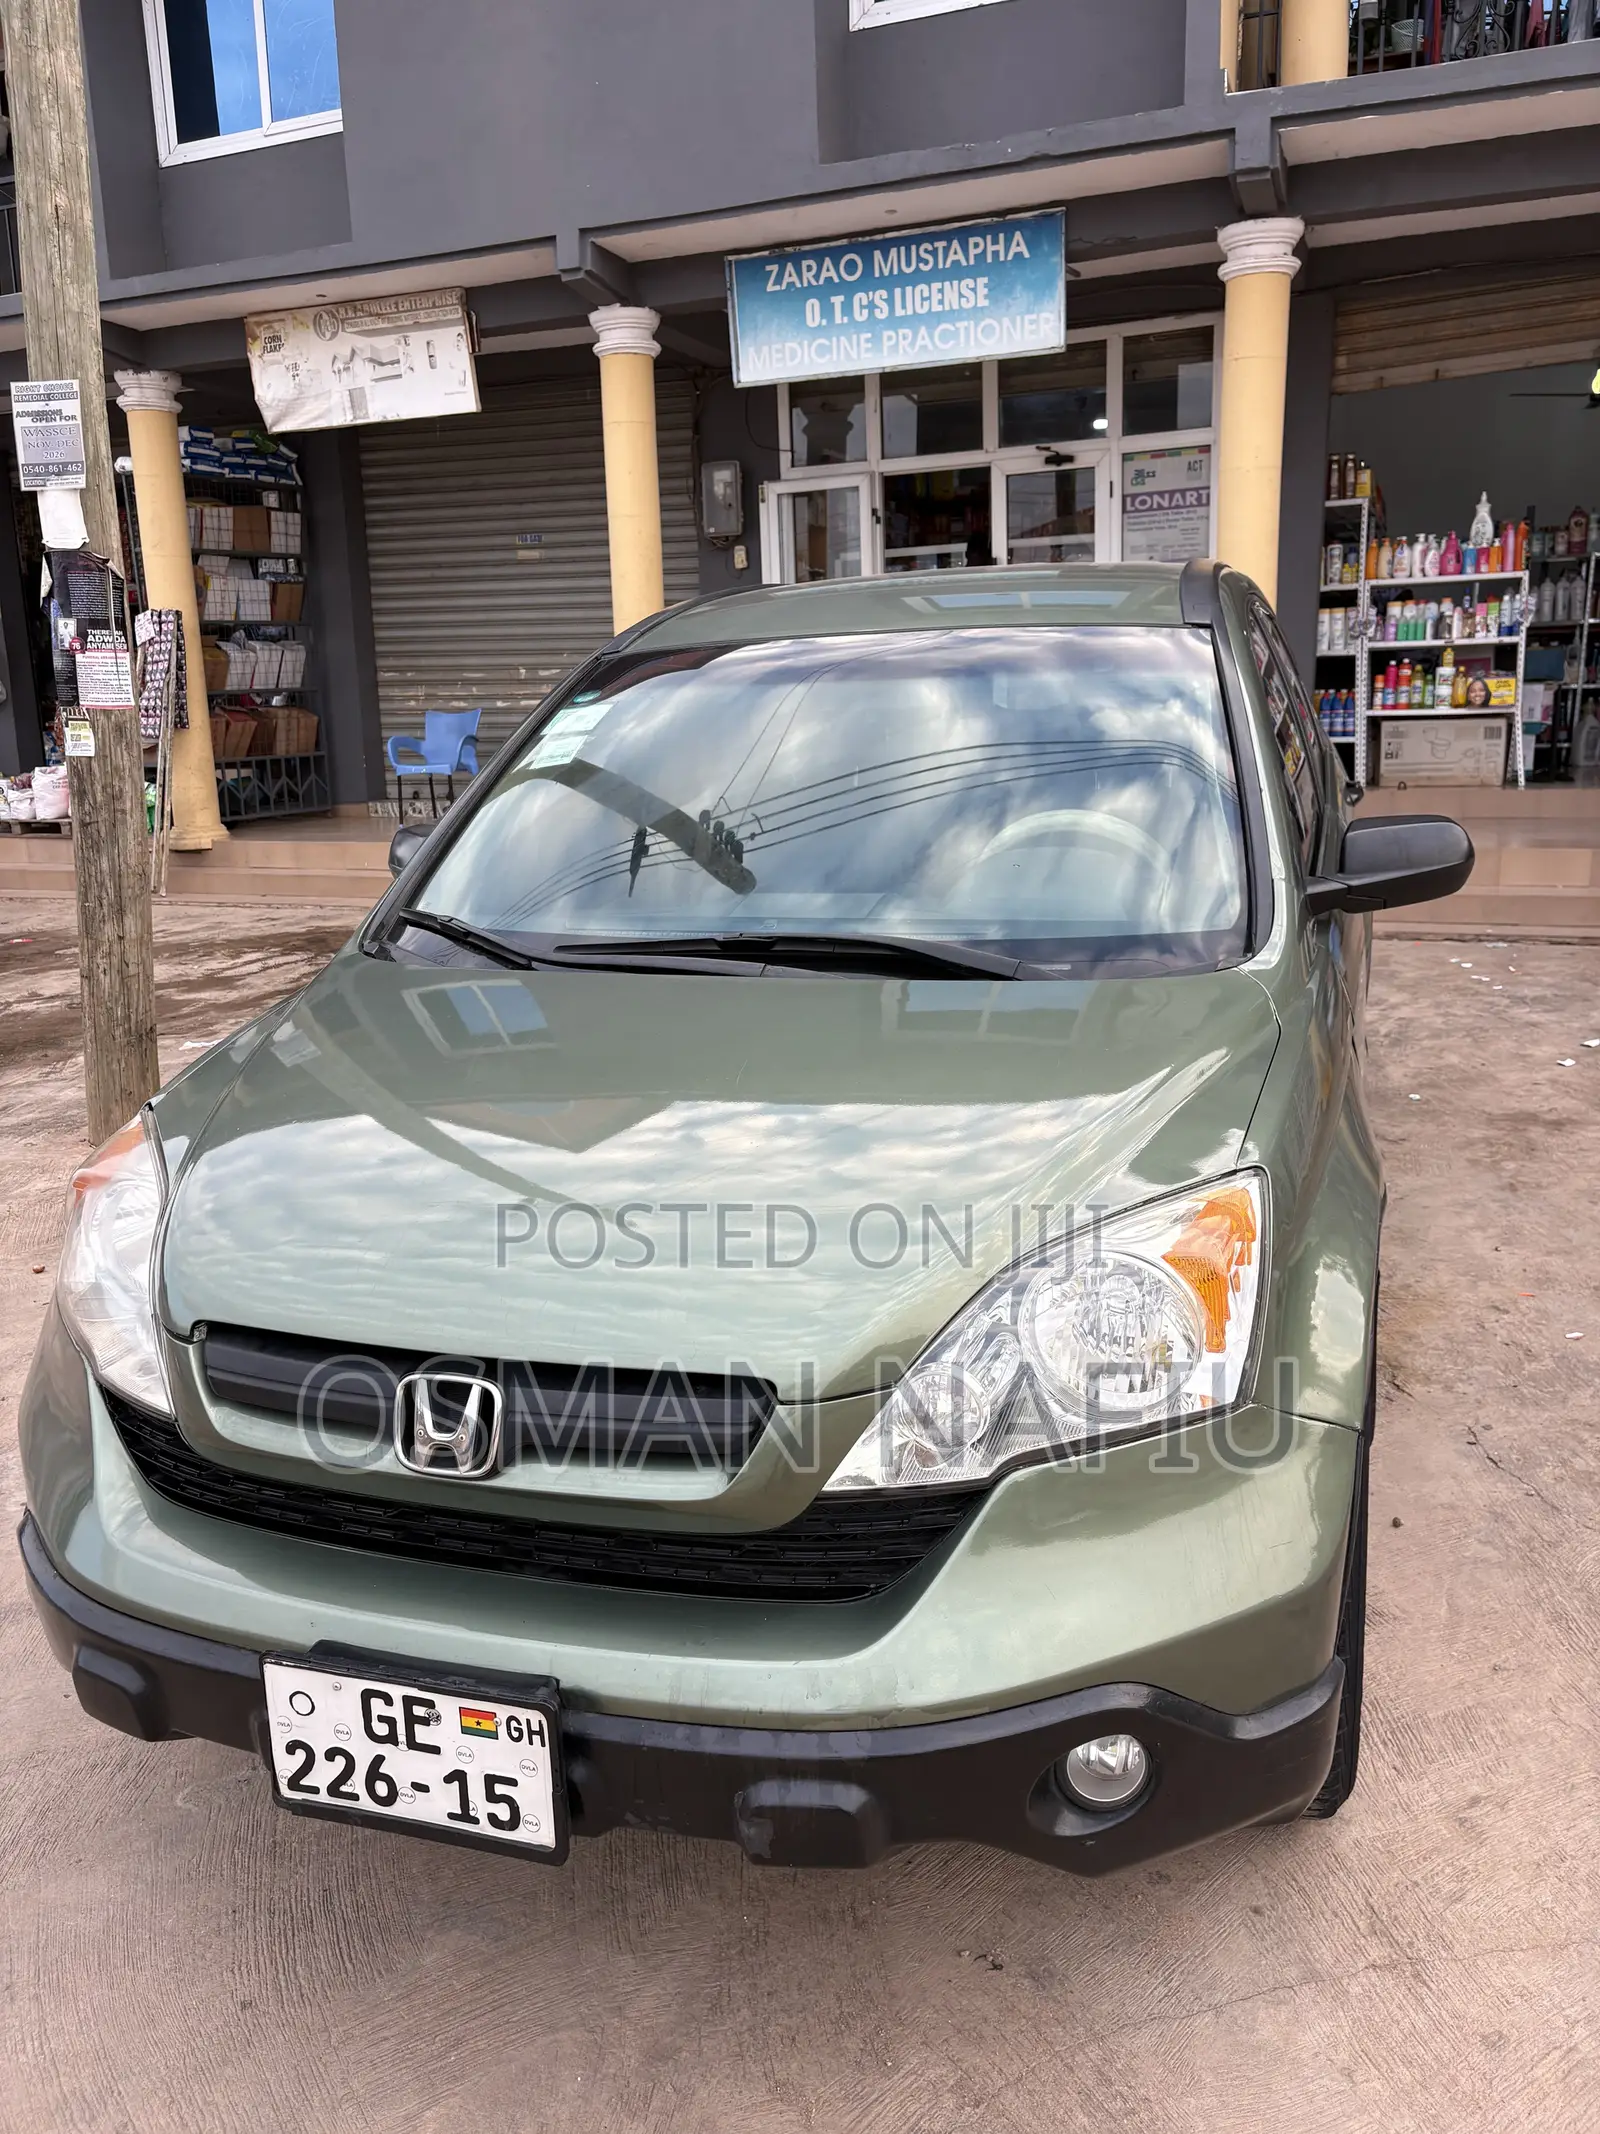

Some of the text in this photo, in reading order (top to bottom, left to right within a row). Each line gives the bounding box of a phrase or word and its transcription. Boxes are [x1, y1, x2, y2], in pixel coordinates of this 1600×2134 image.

[765, 230, 1030, 292] ZARAO MUSTAPHA
[894, 276, 990, 316] LICENSE
[264, 334, 282, 345] CORN
[749, 311, 1055, 374] MEDICINE PRACTIONER
[15, 382, 74, 394] RIGHT CHOICE
[14, 391, 78, 403] REMEDIAL COLLEGE
[15, 408, 63, 418] ADMISSIONS
[59, 414, 78, 422] FOR
[23, 426, 76, 437] WASSCE
[57, 438, 79, 448] DEC
[44, 451, 65, 459] 2026
[23, 463, 83, 474] 0540-861-462
[1186, 459, 1203, 473] ACT
[1125, 488, 1210, 512] LONART
[71, 642, 81, 650] 76
[360, 1688, 546, 1755] GE GH
[285, 1739, 521, 1831] 226-15
